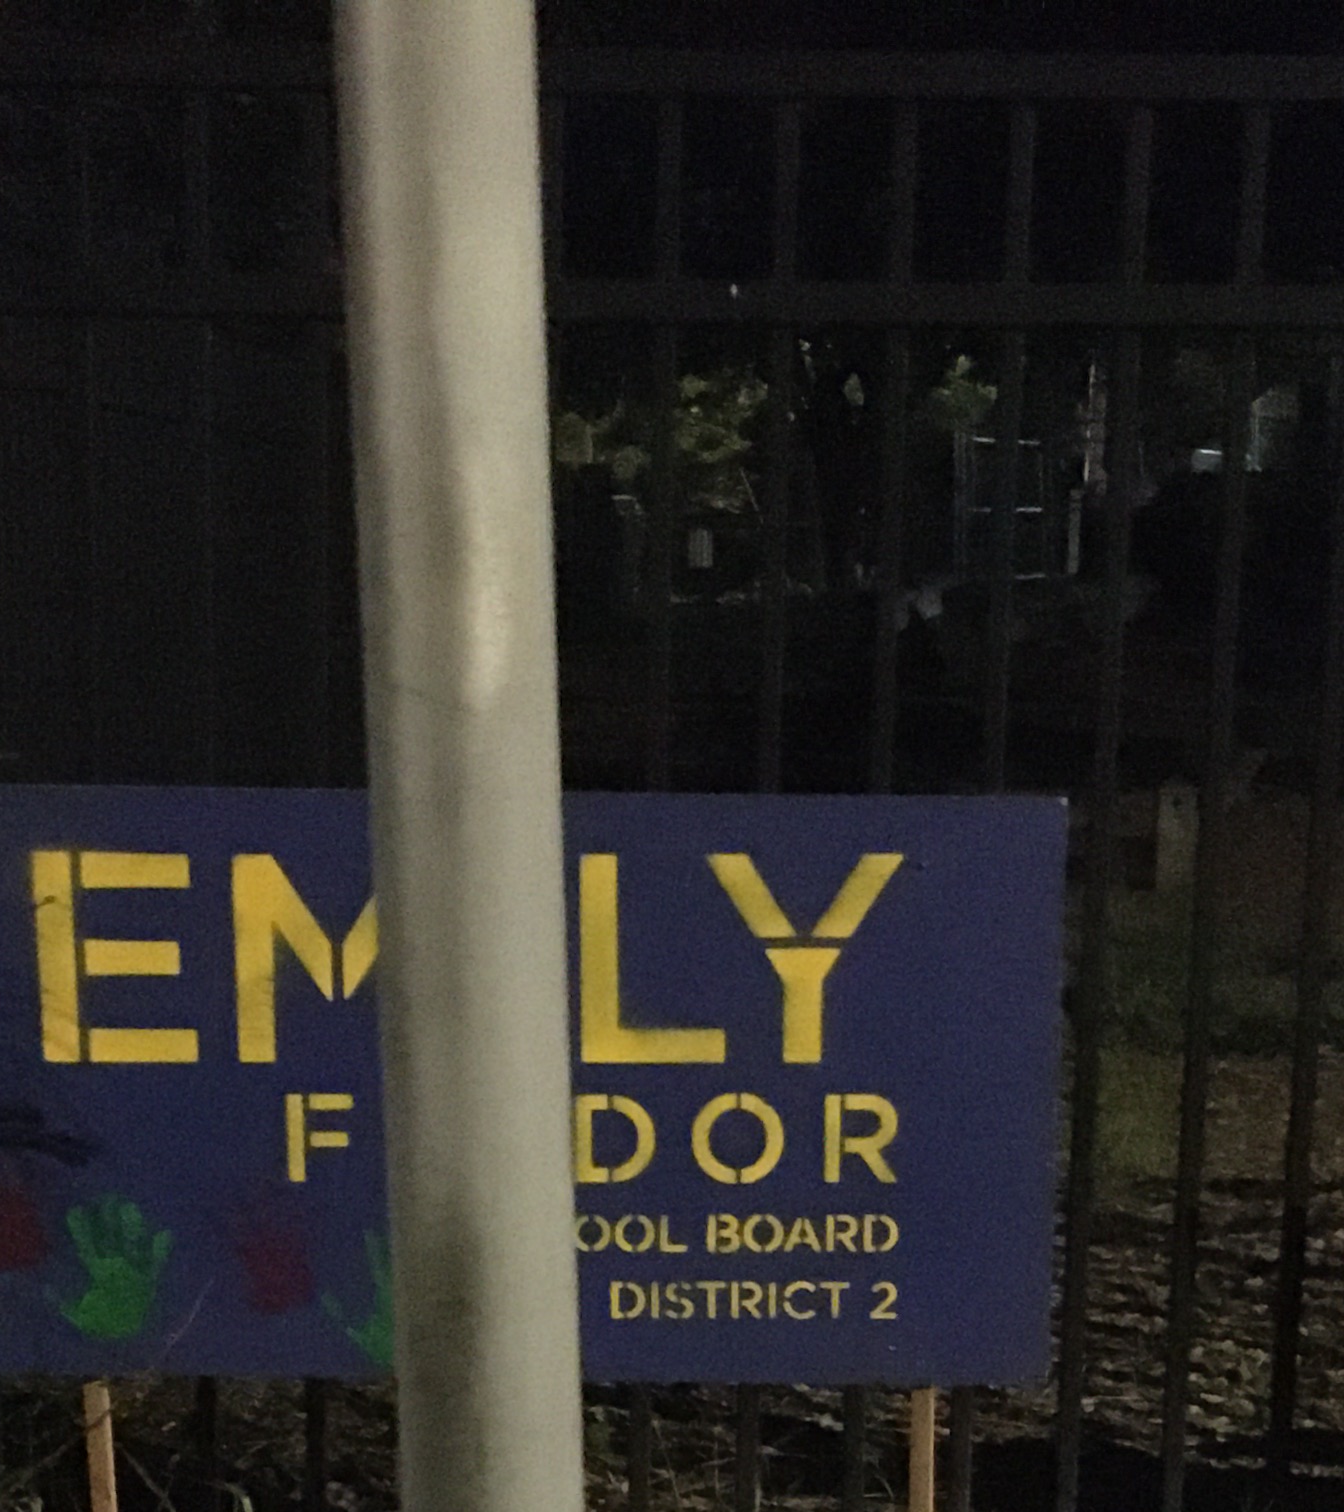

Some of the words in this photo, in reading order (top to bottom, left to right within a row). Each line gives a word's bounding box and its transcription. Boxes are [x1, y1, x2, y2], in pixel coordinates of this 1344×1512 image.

[31, 850, 904, 1063] EMLY
[284, 1092, 898, 1184] FDOR
[574, 1213, 689, 1252] OOL
[705, 1213, 899, 1253] BOARD
[609, 1280, 850, 1320] DISTRICT
[868, 1280, 899, 1320] 2
